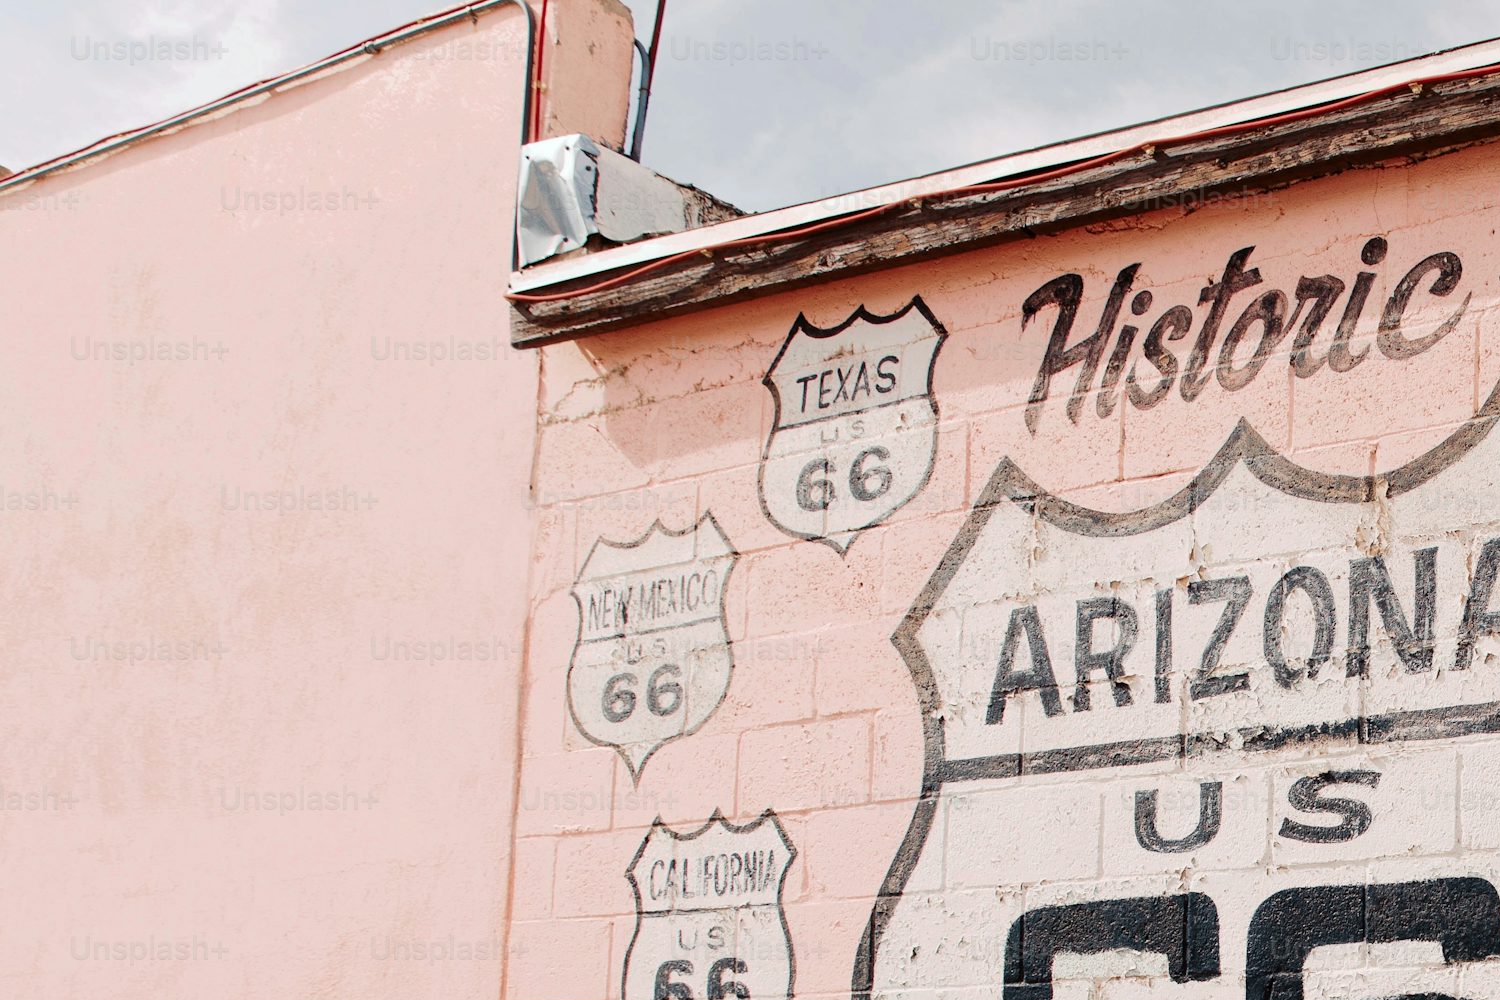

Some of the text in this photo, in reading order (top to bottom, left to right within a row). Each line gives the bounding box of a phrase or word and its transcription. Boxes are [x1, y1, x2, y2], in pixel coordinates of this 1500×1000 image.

[1021, 236, 1472, 436] Historic
[796, 355, 899, 413] TEXAS
[796, 446, 893, 512] 66
[588, 569, 718, 631] NEW MEXICO
[602, 663, 683, 722] 66
[650, 850, 776, 900] CALIFORNIA
